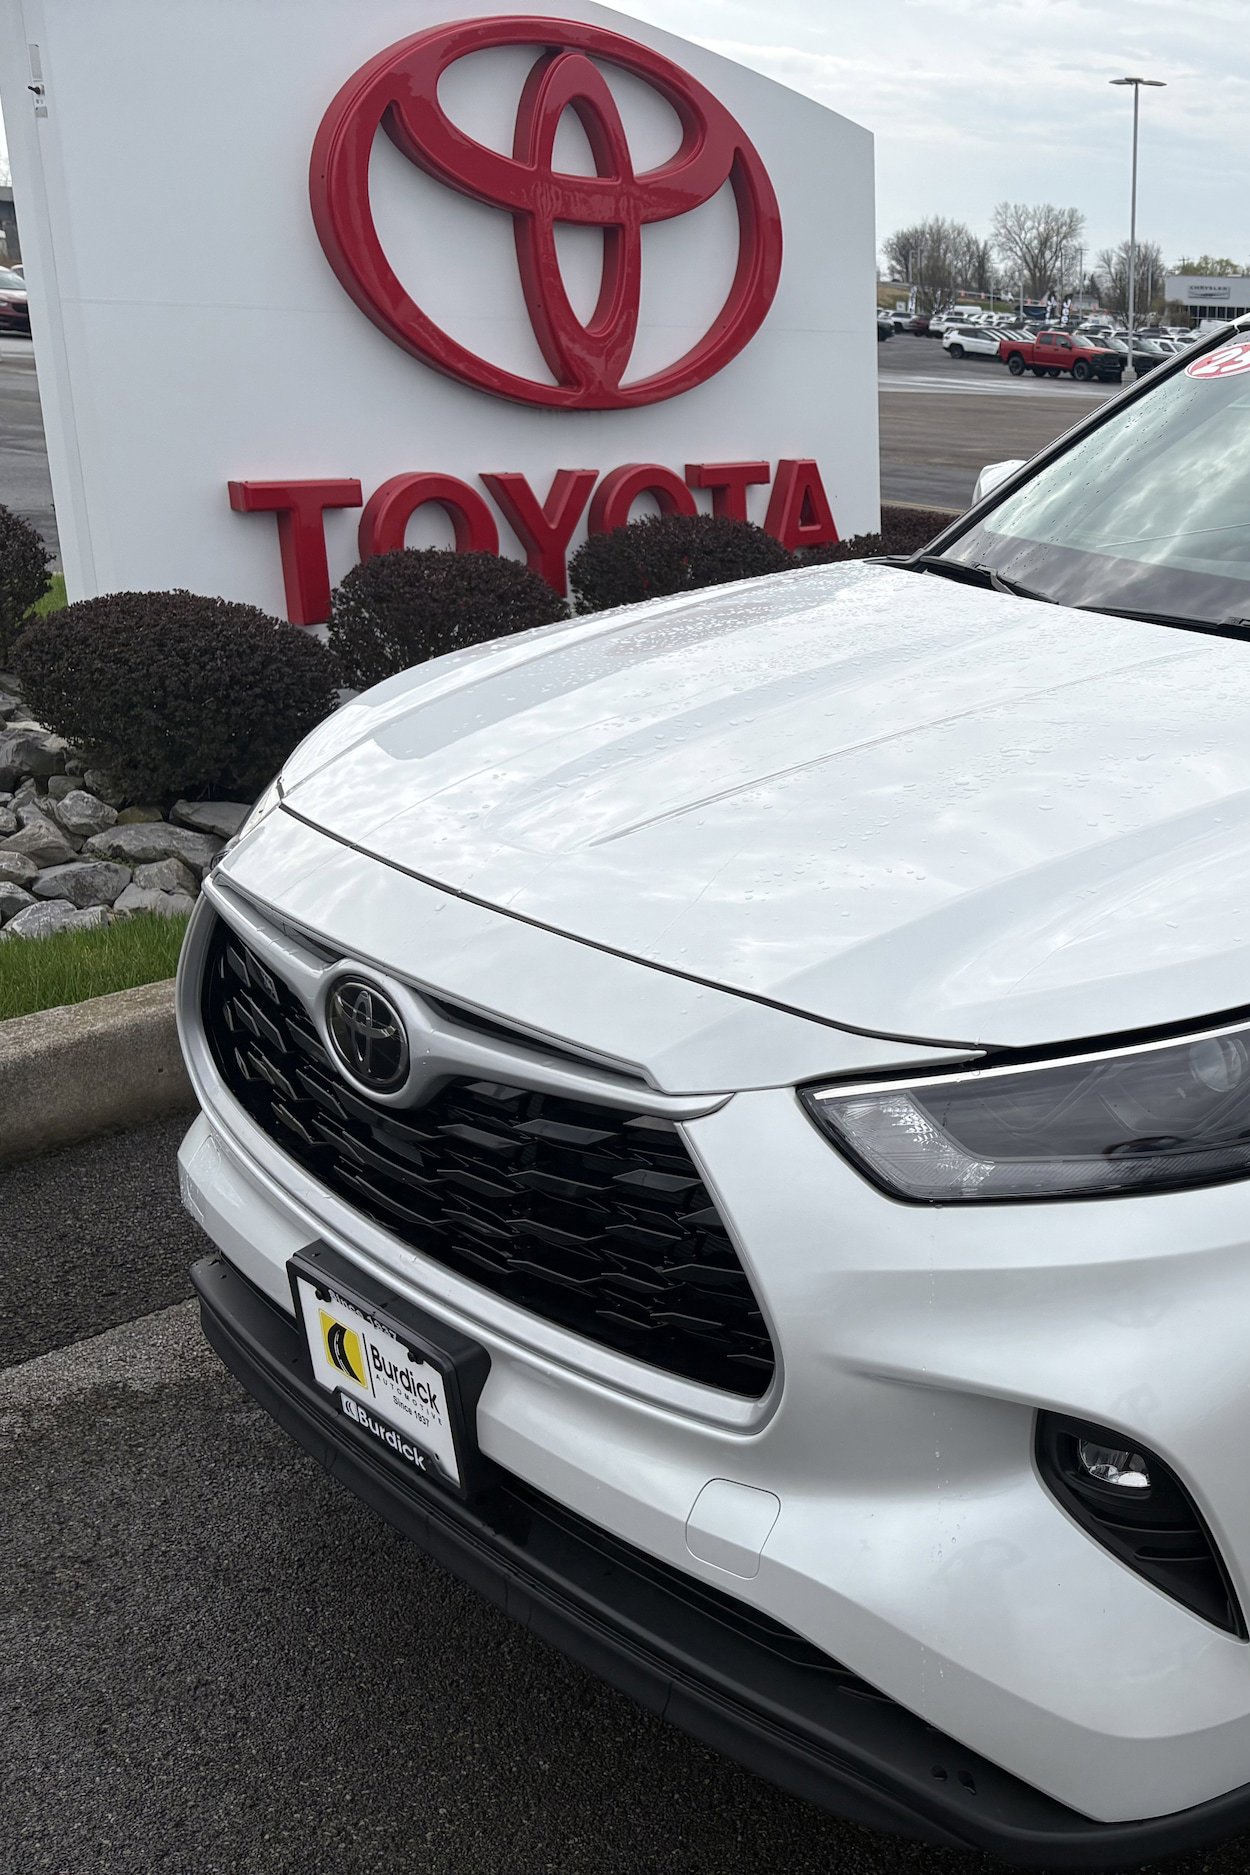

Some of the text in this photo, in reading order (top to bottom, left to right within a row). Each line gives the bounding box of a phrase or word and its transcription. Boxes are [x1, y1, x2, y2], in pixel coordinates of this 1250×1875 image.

[227, 457, 841, 626] TOYOTA
[370, 1344, 441, 1415] Burdick
[376, 1374, 442, 1426] AUTOMOTIVE
[393, 1395, 430, 1428] Since 1937
[357, 1405, 427, 1472] Burdick
